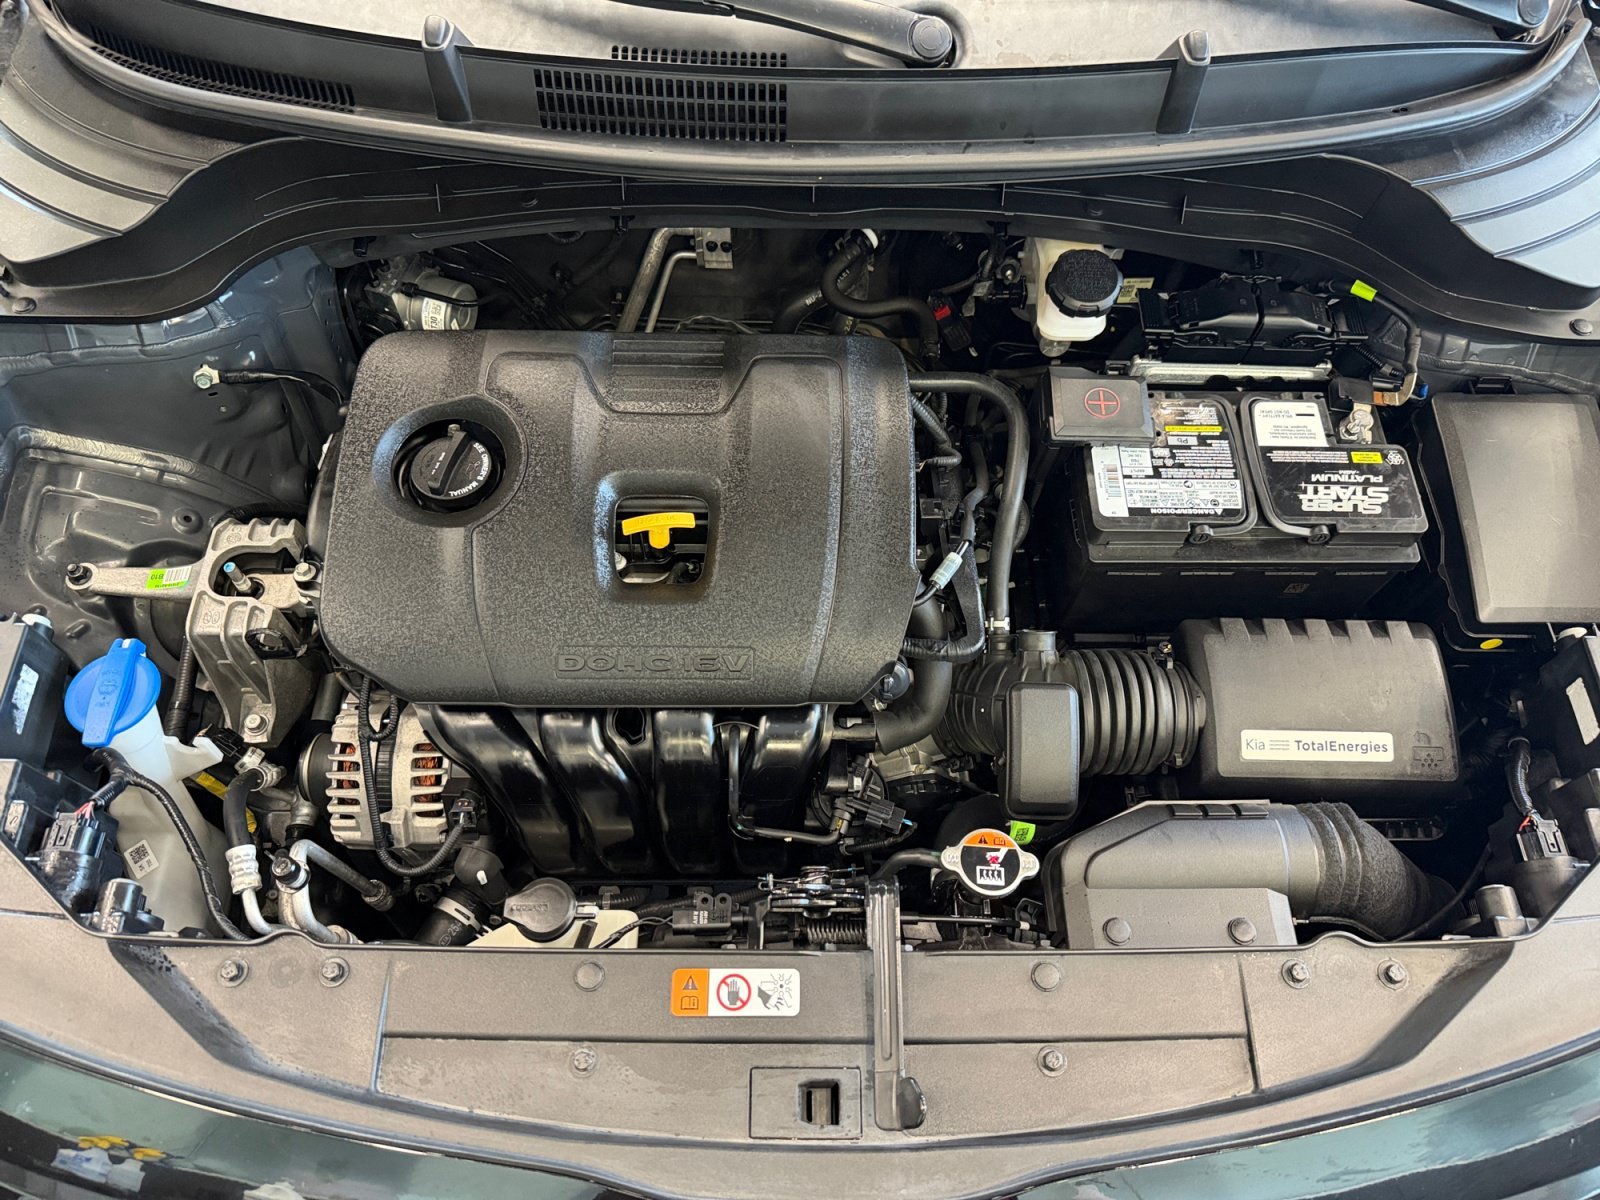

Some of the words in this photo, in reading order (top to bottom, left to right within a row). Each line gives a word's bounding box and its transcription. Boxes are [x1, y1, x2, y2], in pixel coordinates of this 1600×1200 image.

[473, 442, 485, 454] SEE
[477, 454, 489, 481] OWNER'S
[1311, 474, 1383, 483] PLATINUM
[448, 481, 479, 497] MANUAL
[1298, 488, 1389, 503] START
[1301, 499, 1382, 514] SUPER
[556, 654, 671, 673] DOHC
[683, 654, 751, 674] 16V
[1245, 738, 1266, 751] Kia
[1294, 740, 1389, 755] TotalEnergies
